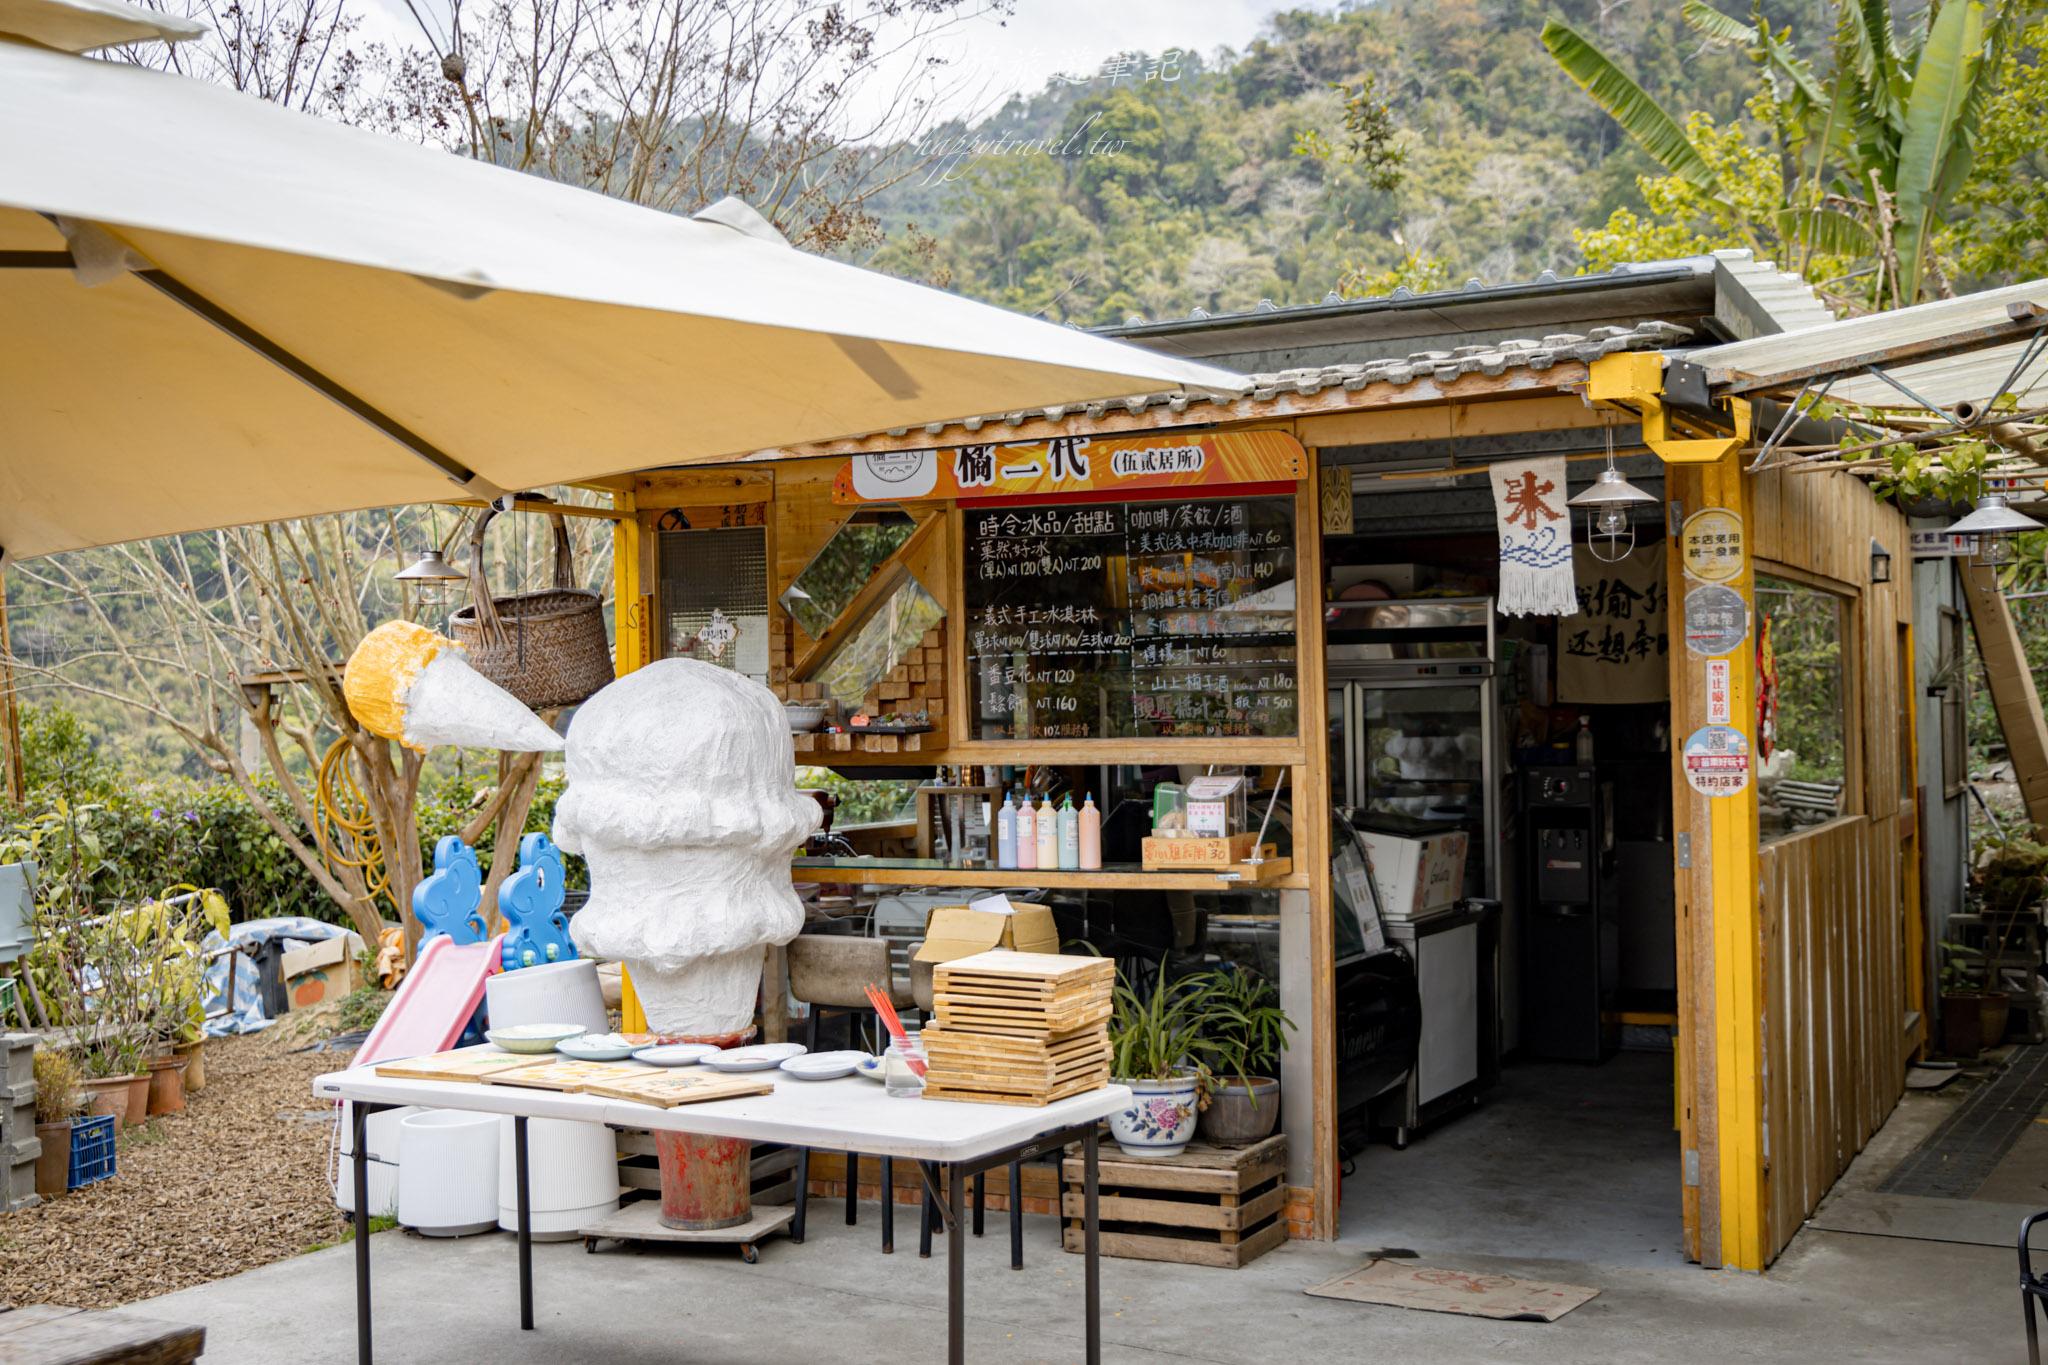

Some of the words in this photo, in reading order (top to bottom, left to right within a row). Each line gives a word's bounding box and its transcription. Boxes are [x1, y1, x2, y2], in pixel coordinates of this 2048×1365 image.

[1131, 504, 1243, 529] 咖啡/茶飲/酒
[979, 510, 1115, 537] 時令冰品/甜點
[1688, 533, 1741, 545] 本店免用
[1688, 546, 1741, 558] 統一發票
[1695, 775, 1744, 788] 特約店家
